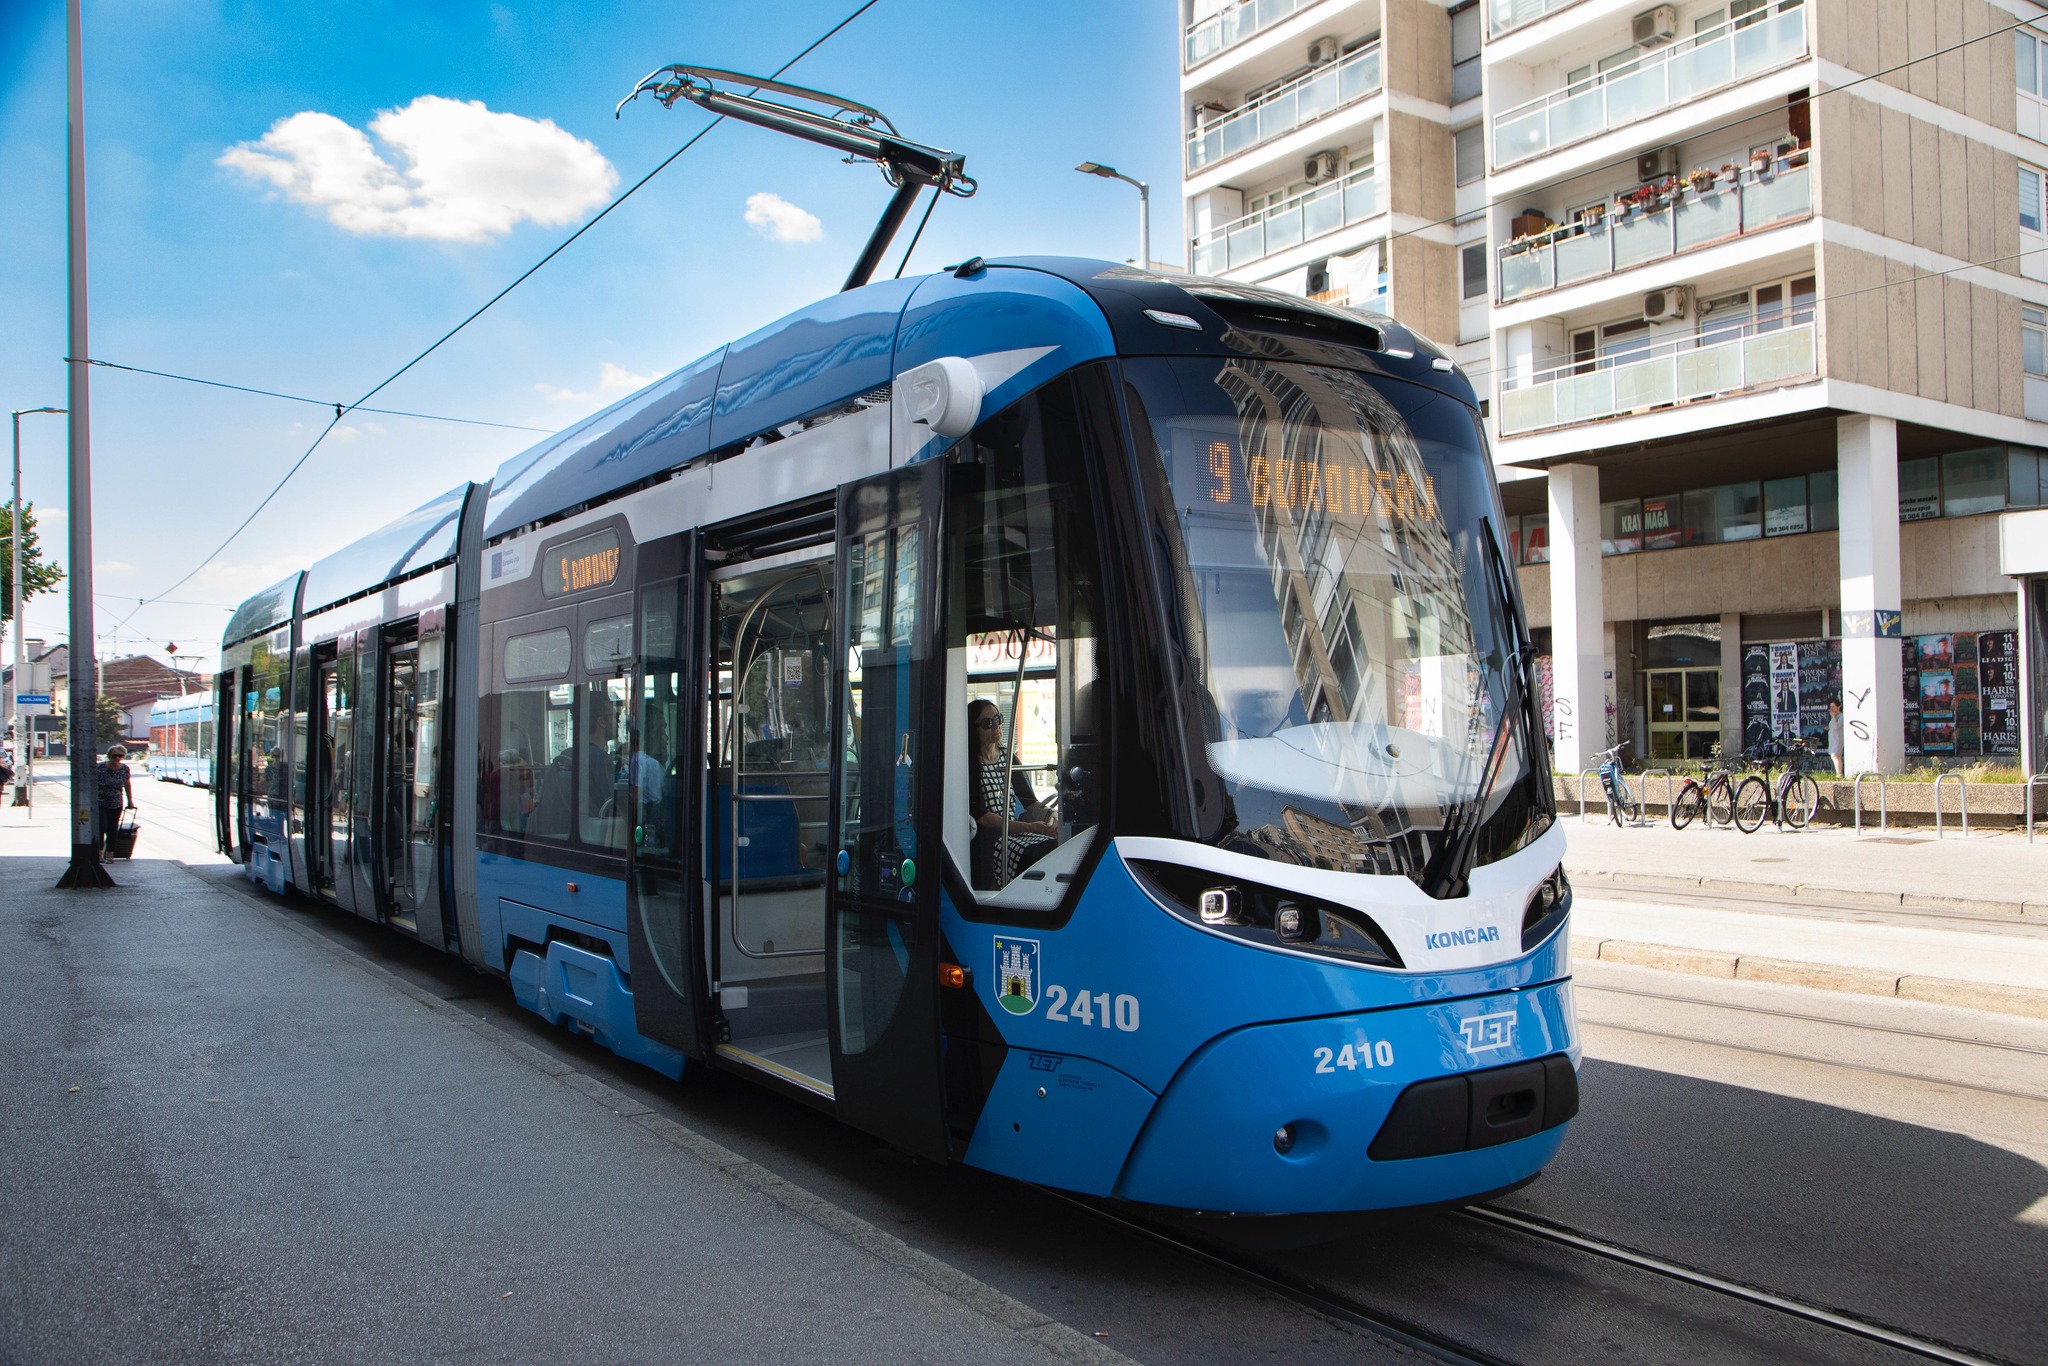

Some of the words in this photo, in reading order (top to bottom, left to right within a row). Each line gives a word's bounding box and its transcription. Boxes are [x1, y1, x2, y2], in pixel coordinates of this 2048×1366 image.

[1208, 440, 1232, 503] 9
[1251, 455, 1436, 521] BORONGAJ
[1644, 510, 1669, 530] MAGA
[561, 557, 570, 592] 9
[2003, 634, 2014, 642] 11.
[2002, 642, 2014, 650] 10.
[2004, 663, 2015, 672] 11.
[2002, 672, 2016, 680] 10.
[1982, 686, 2016, 696] HARIS
[2006, 709, 2017, 718] 11.
[2004, 718, 2017, 726] 10.
[1983, 732, 2016, 741] HARIS
[1425, 926, 1500, 950] KONČAR
[1046, 984, 1140, 1032] 2410
[1460, 1010, 1517, 1054] ZET
[1028, 1053, 1064, 1073] ZET
[1313, 1040, 1394, 1074] 2410
